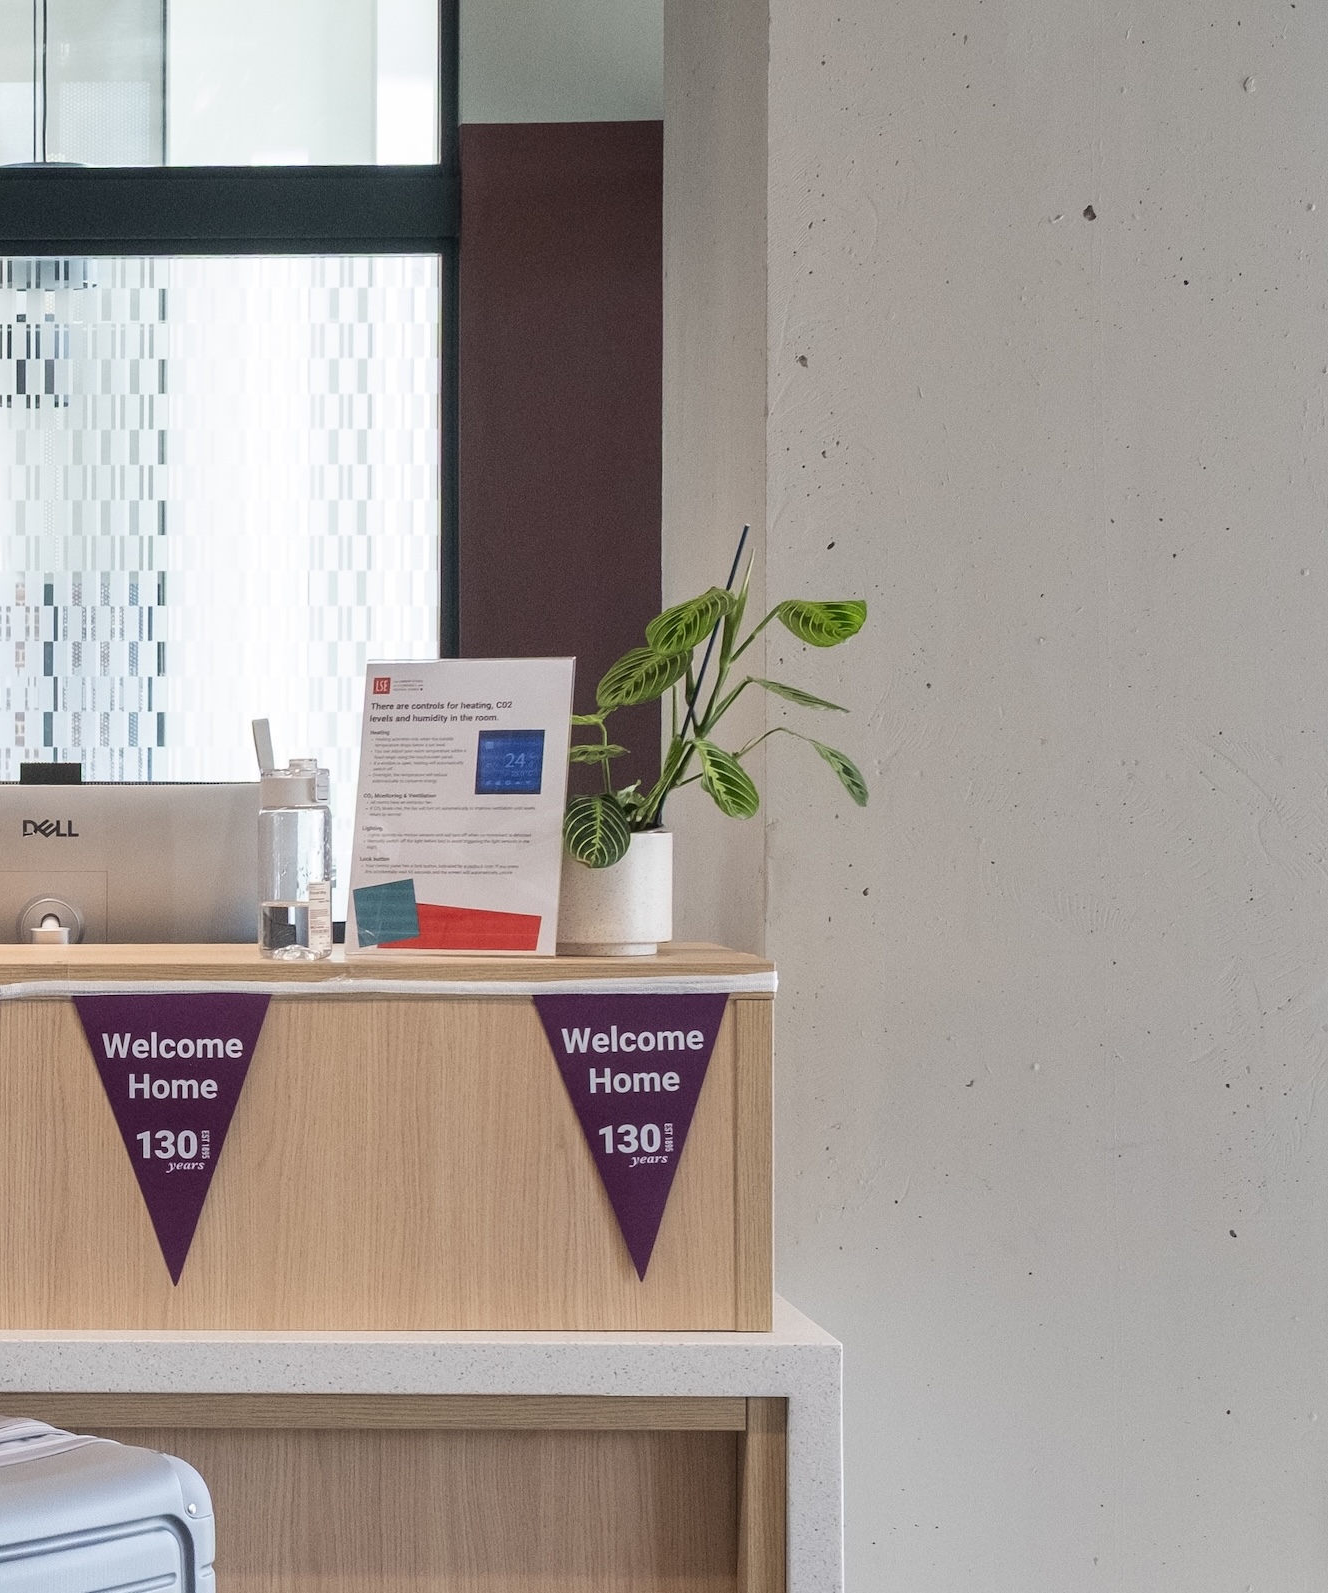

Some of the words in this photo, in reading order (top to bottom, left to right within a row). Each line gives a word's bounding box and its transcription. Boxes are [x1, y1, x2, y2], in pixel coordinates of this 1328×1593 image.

[375, 680, 388, 692] LSE
[411, 702, 444, 710] controls
[460, 702, 494, 711] heating,
[412, 714, 448, 724] humidity
[505, 753, 526, 768] 24
[23, 819, 79, 838] DELL
[102, 1031, 243, 1059] Welcome
[561, 1025, 705, 1054] Welcome
[128, 1073, 218, 1099] Home
[589, 1067, 681, 1094] Home
[201, 1130, 210, 1142] EST
[663, 1122, 673, 1136] EST
[136, 1129, 198, 1159] 130
[598, 1123, 661, 1154] 130
[165, 1162, 205, 1174] years
[628, 1155, 668, 1168] years
